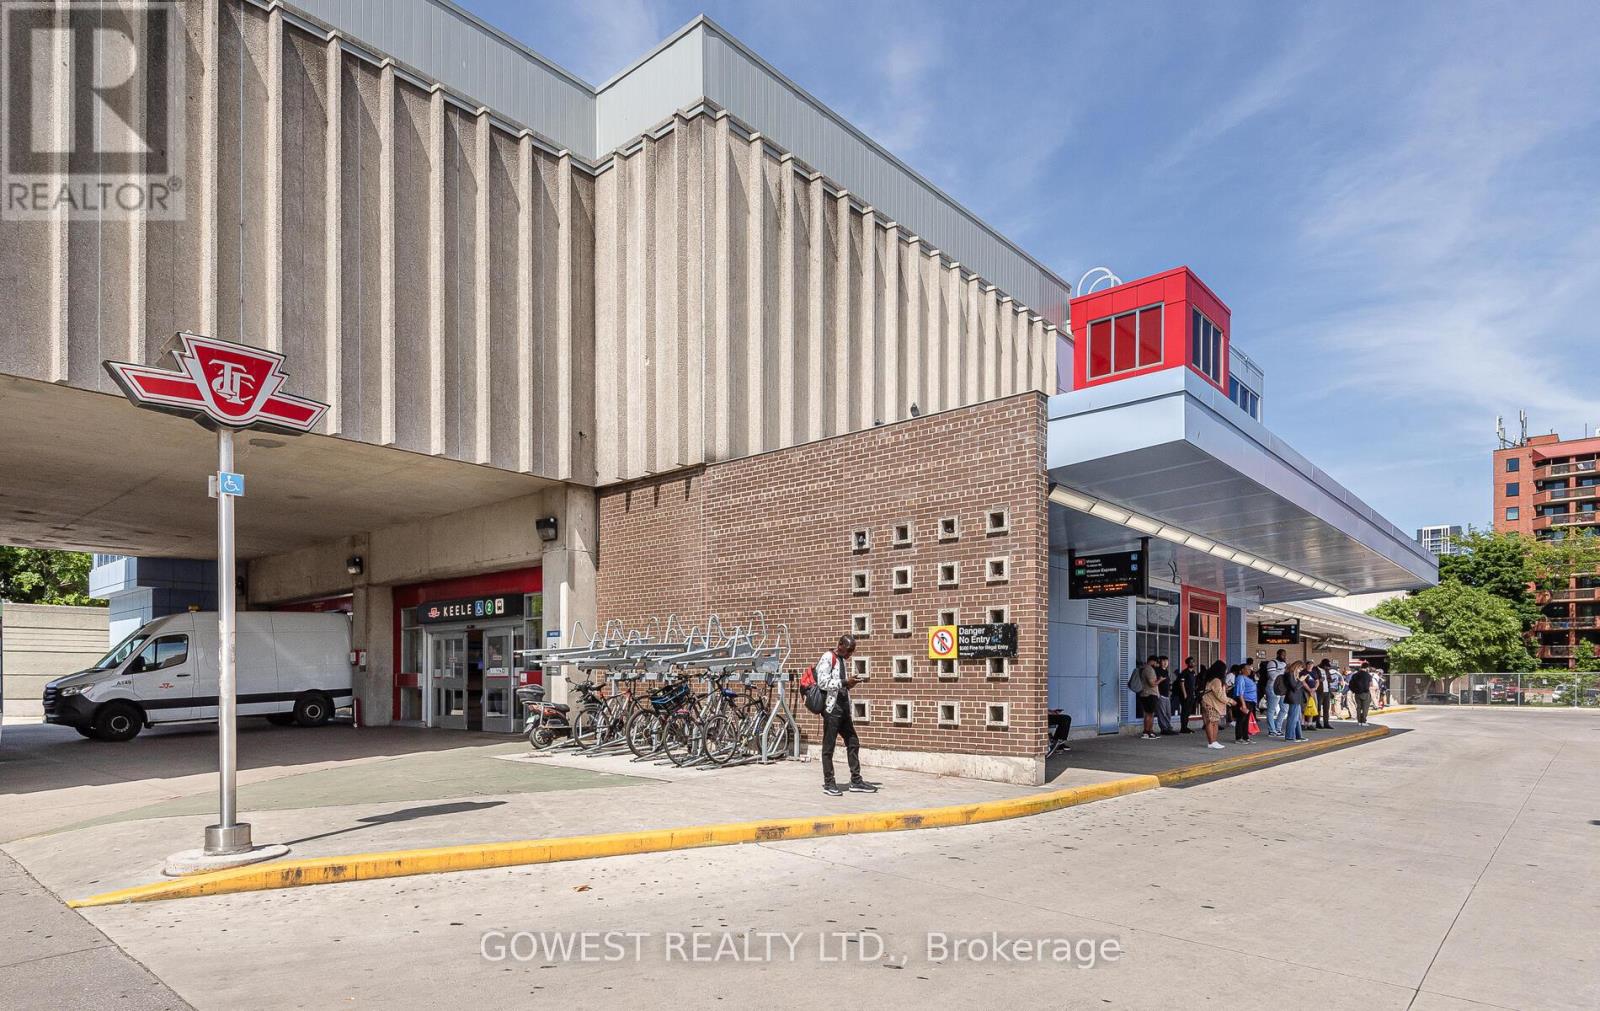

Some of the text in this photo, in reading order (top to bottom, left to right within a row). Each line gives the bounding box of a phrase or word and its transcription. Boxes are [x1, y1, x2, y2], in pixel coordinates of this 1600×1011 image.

[443, 603, 472, 617] KEELE
[959, 628, 985, 636] Danger
[959, 636, 970, 644] No
[971, 635, 991, 645] Entry
